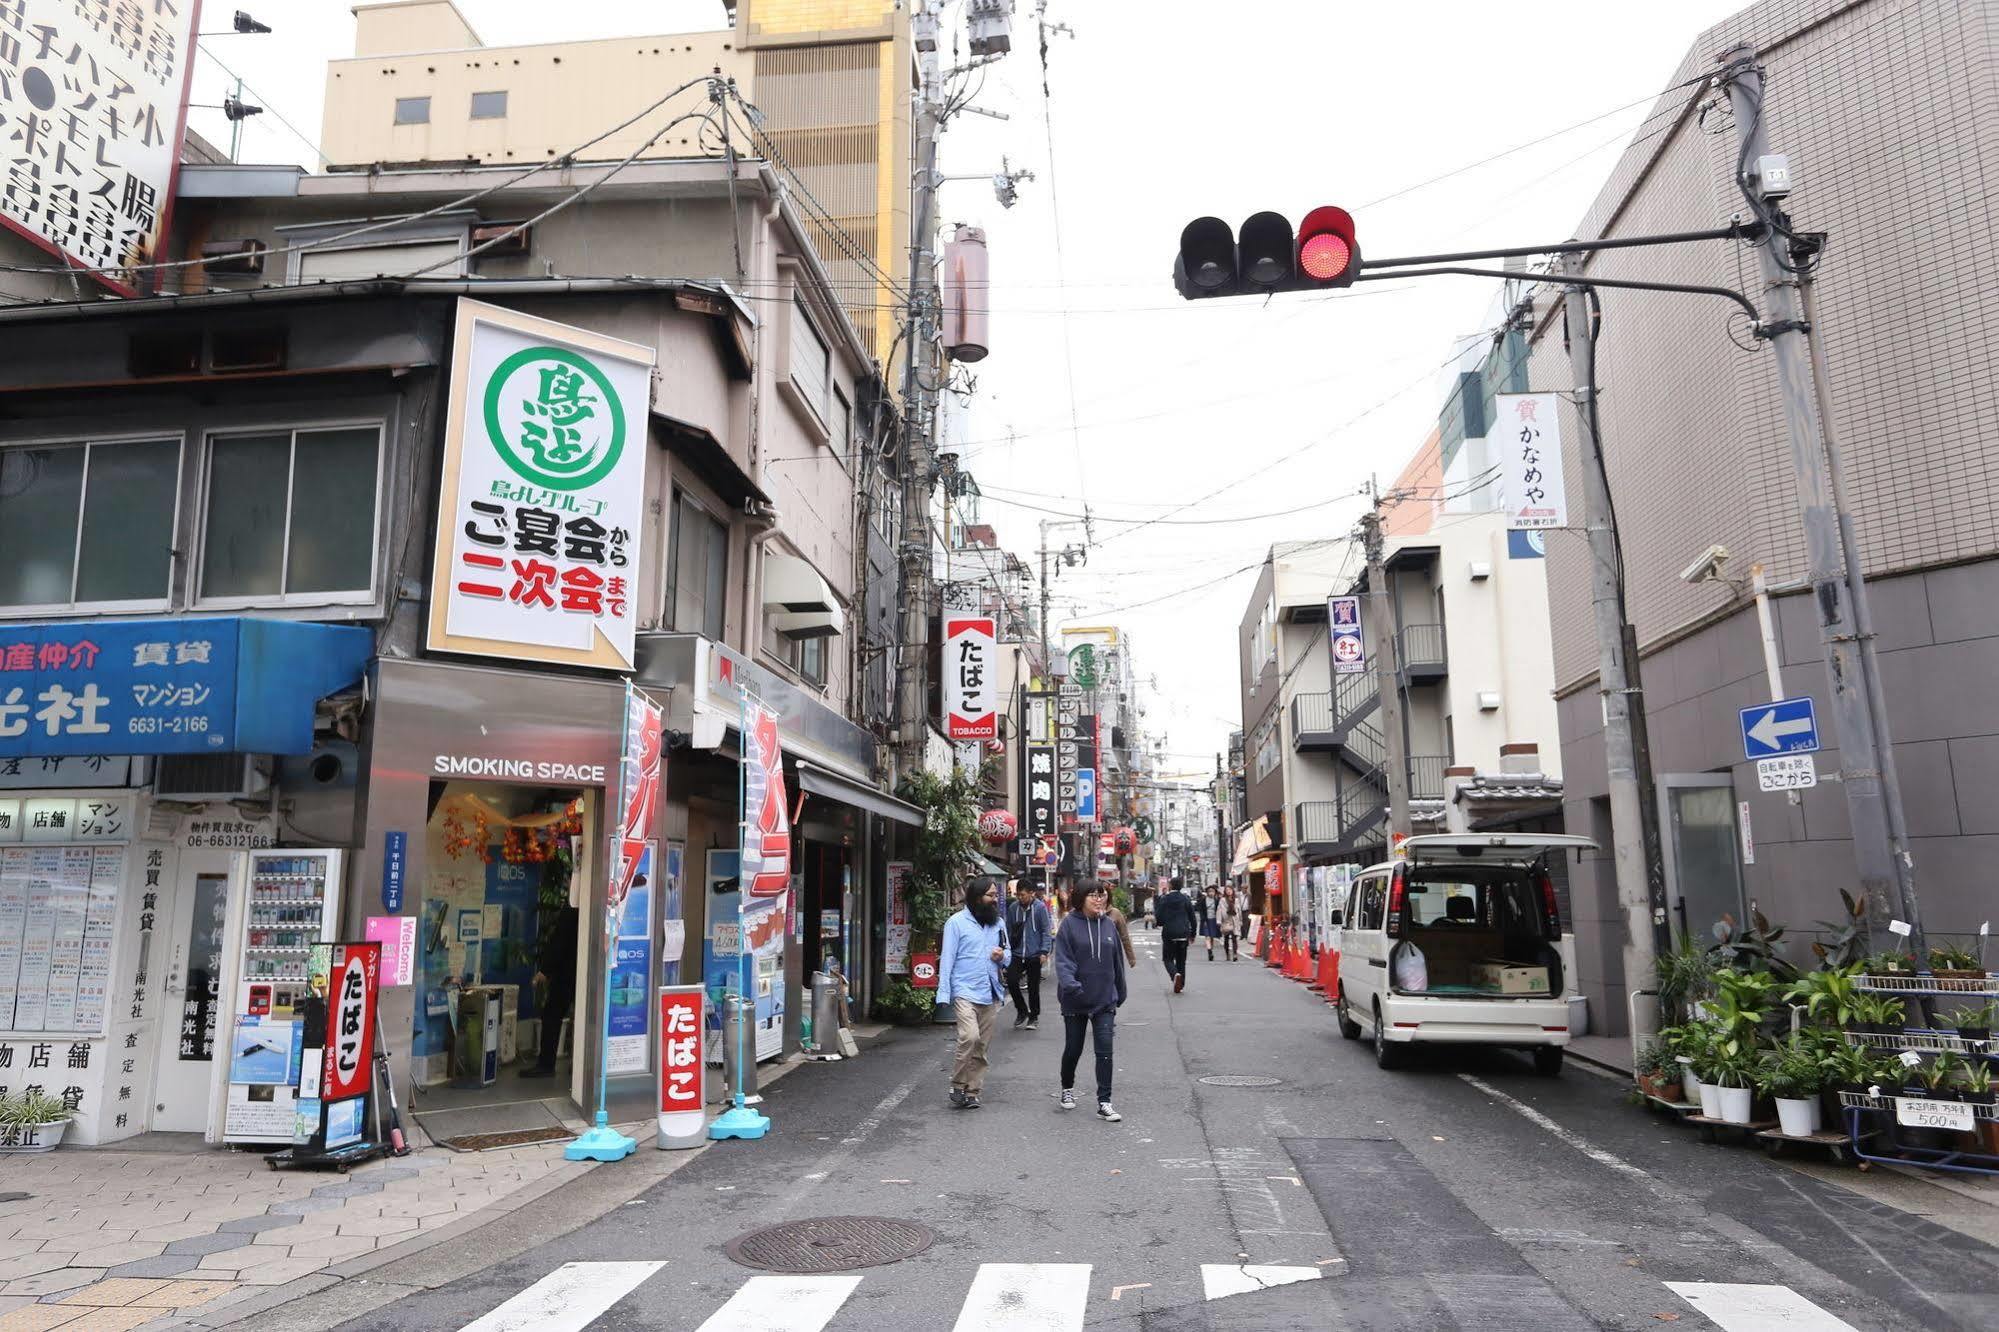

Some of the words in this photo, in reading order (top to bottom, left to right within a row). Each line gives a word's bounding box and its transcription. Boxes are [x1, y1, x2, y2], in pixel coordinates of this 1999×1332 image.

[1520, 426, 1544, 504] かなめや
[0, 640, 101, 672] 産仲介
[133, 641, 212, 667] 賃貸
[960, 640, 983, 712] たばこ
[132, 683, 210, 707] マンション
[128, 717, 208, 734] 6631-2166
[434, 756, 533, 777] SMOKING
[537, 763, 605, 782] SPACE
[1760, 759, 1811, 774] 自転車を除く
[1762, 772, 1812, 787] ここから
[33, 812, 66, 828] 店舗
[368, 950, 377, 991] シガー
[400, 920, 415, 983] Welcome
[130, 971, 147, 1019] 南光社
[180, 1000, 199, 1056] 南光社
[339, 969, 363, 1071] たばこ
[667, 1004, 696, 1100] たばこ
[115, 1032, 138, 1128] 査定無料
